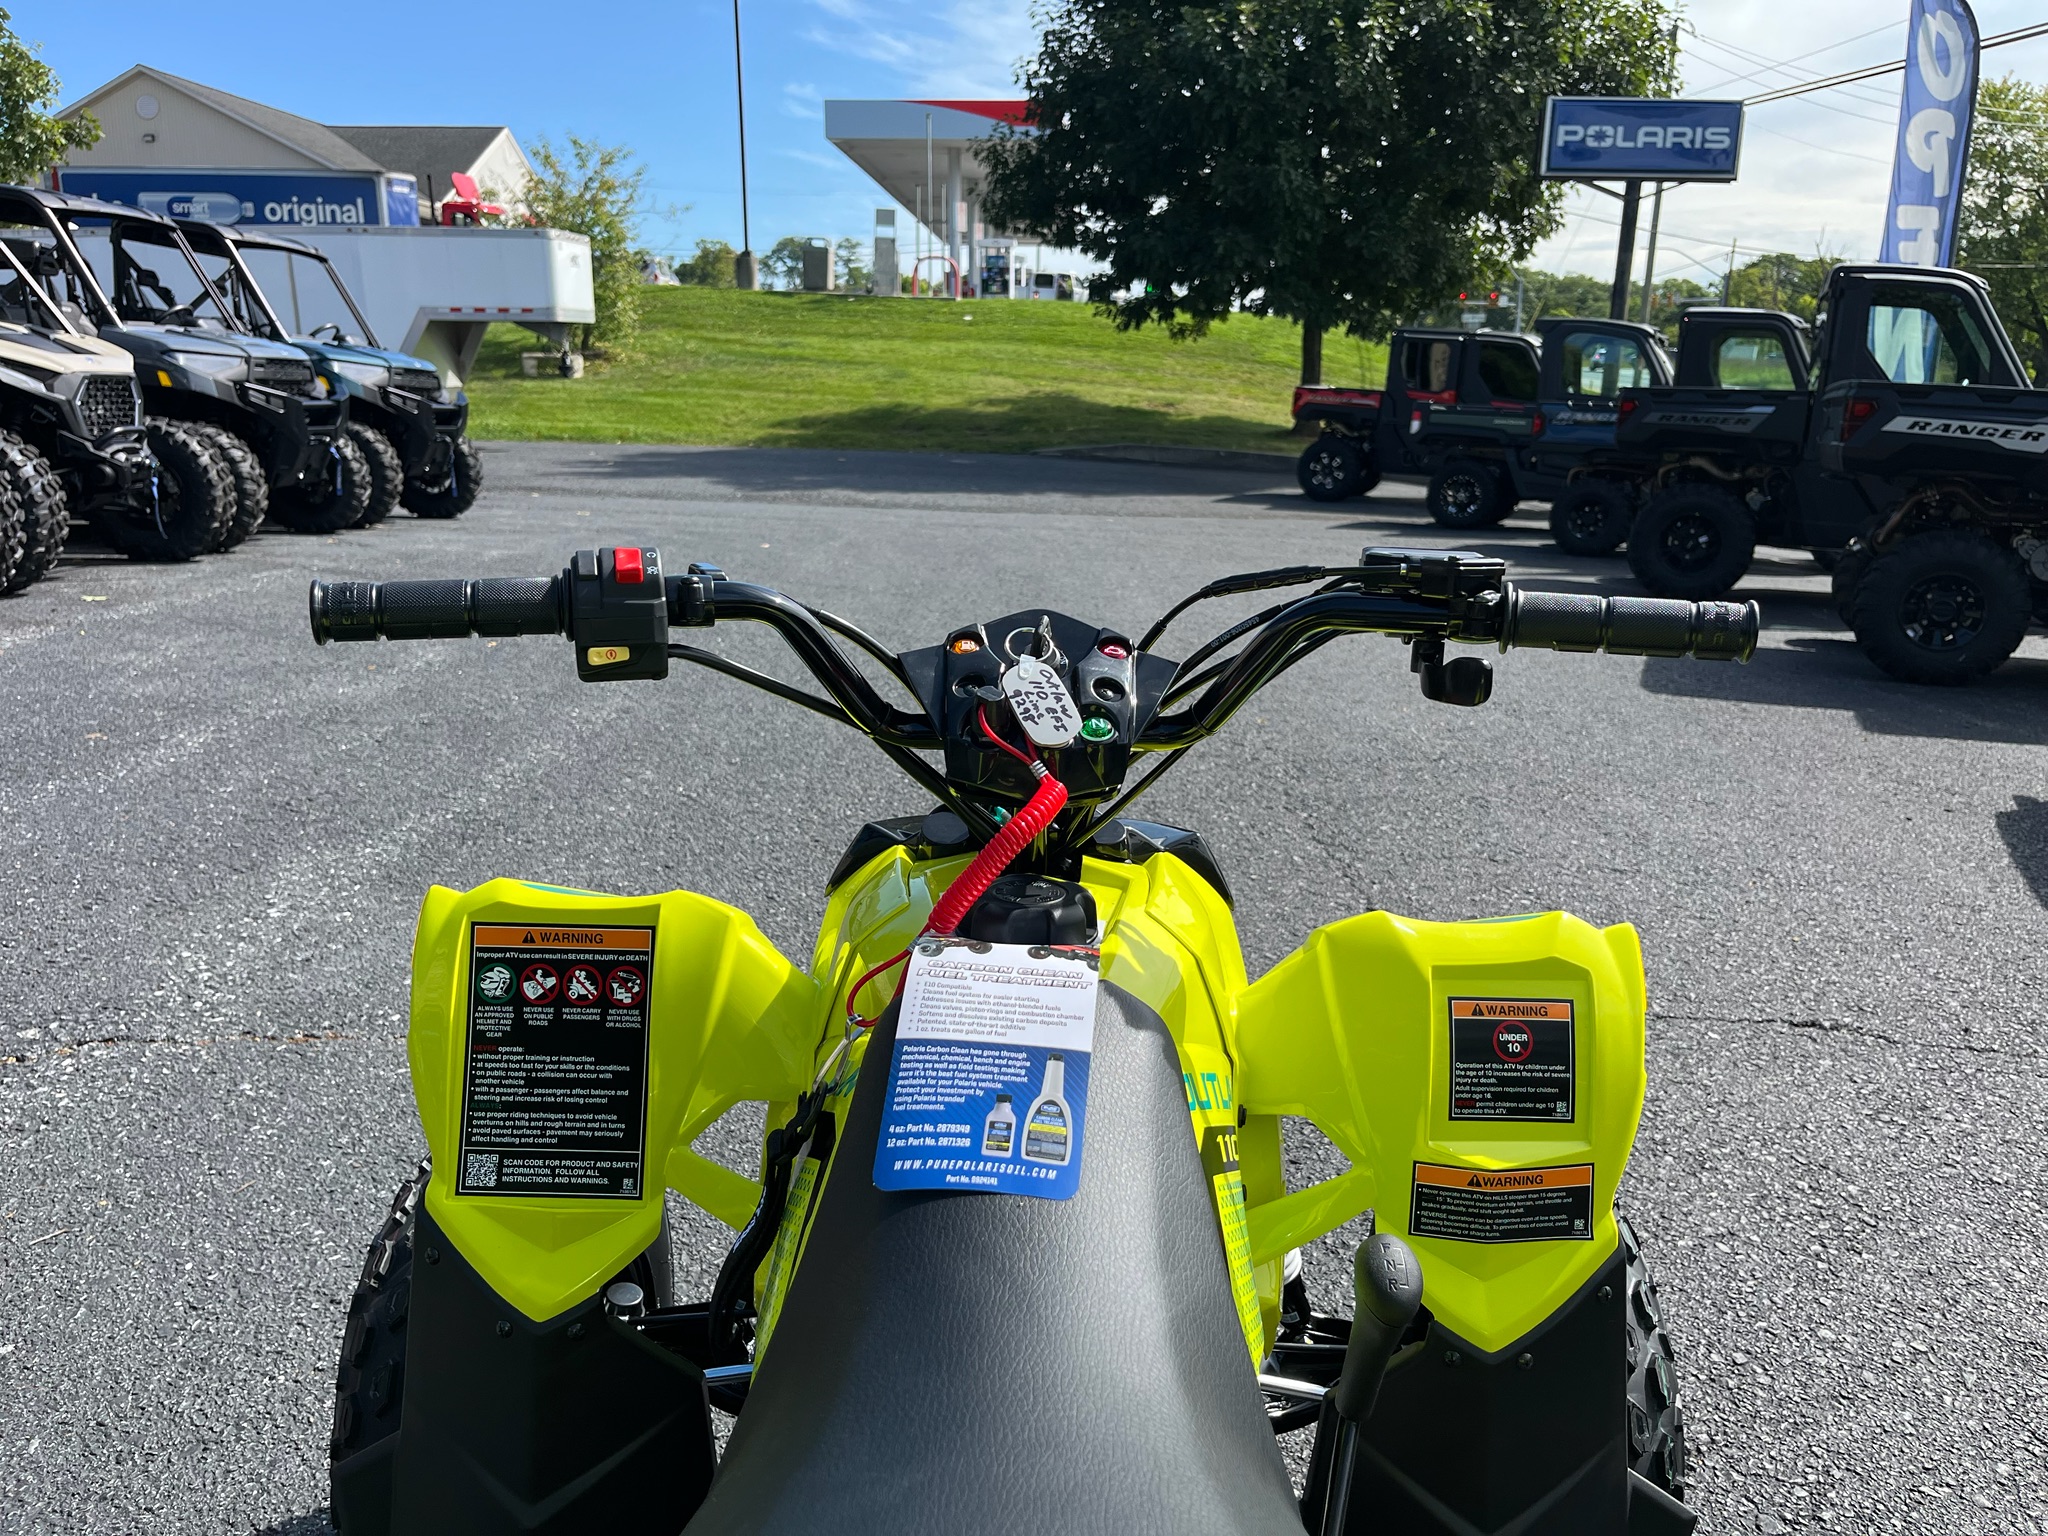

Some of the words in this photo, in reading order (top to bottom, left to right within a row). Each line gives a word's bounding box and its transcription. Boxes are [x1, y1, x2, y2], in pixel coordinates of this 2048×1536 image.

[1556, 125, 1731, 149] POLARIS
[172, 202, 209, 214] smart
[264, 196, 365, 226] original
[1658, 413, 1751, 426] RANGER
[1906, 420, 2046, 442] RANGER
[1028, 681, 1048, 700] 110
[1045, 706, 1068, 732] EFI
[1092, 719, 1104, 728] N
[540, 932, 604, 944] WARNING
[928, 960, 1013, 974] CARBON
[1017, 968, 1084, 979] CLEAN
[916, 969, 968, 980] FUEL
[971, 974, 1092, 989] TREATMENT
[937, 982, 972, 990] Compatible
[1486, 1006, 1548, 1016] WARNING
[1508, 1043, 1520, 1052] 10
[983, 1050, 1000, 1058] gone
[1001, 1050, 1027, 1060] through
[921, 1087, 936, 1096] your
[975, 1088, 984, 1097] by
[937, 1095, 966, 1103] branded
[889, 1125, 895, 1133] 4
[906, 1124, 923, 1132] Part
[923, 1123, 935, 1132] No.
[887, 1138, 896, 1147] 12
[908, 1137, 924, 1146] Part
[925, 1137, 937, 1146] No.
[894, 1160, 1057, 1179] WWW.PUREPOLARISOIL.COM
[946, 1175, 960, 1183] Part
[960, 1175, 970, 1183] No.
[1482, 1174, 1543, 1187] WARNING
[1380, 1243, 1390, 1254] F
[1384, 1259, 1396, 1272] N
[1388, 1278, 1398, 1292] R
